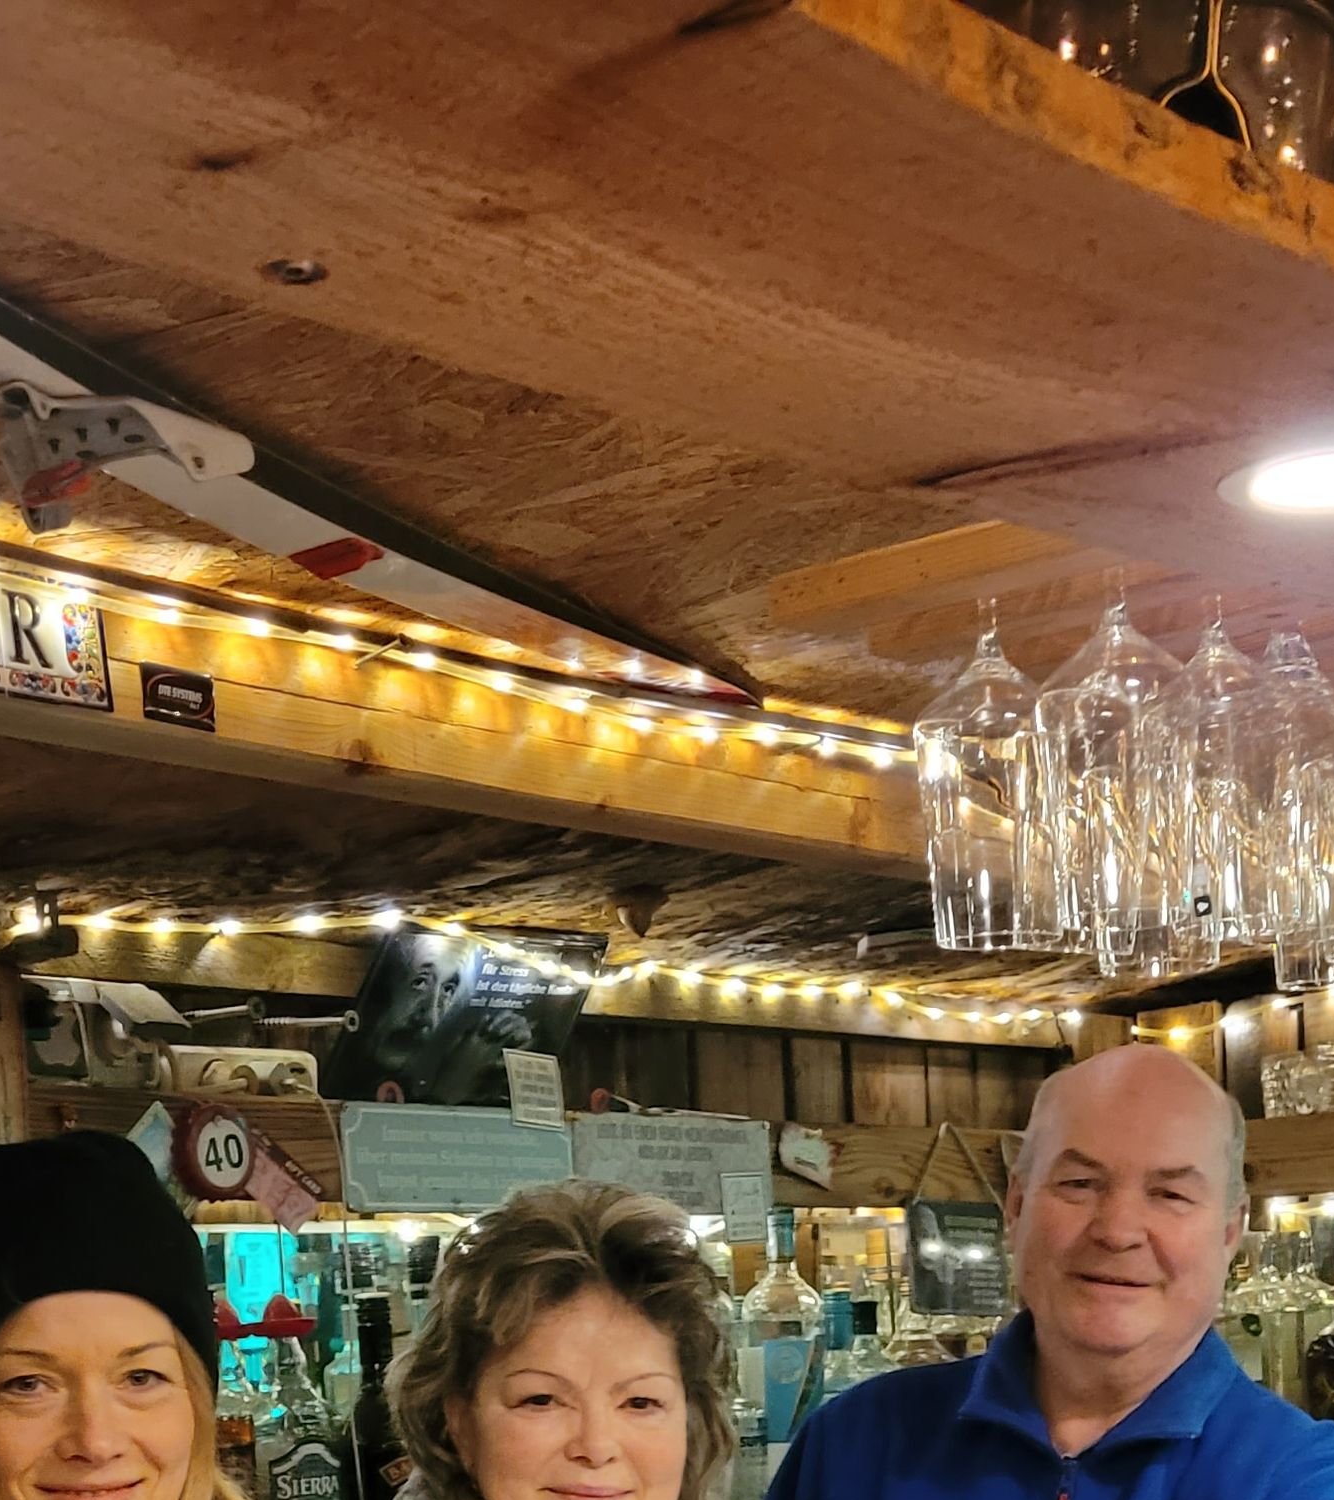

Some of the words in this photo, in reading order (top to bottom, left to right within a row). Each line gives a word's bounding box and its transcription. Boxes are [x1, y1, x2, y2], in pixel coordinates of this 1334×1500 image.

[498, 964, 530, 977] Stress
[204, 1133, 245, 1172] 40
[276, 1474, 340, 1500] SIERRA
